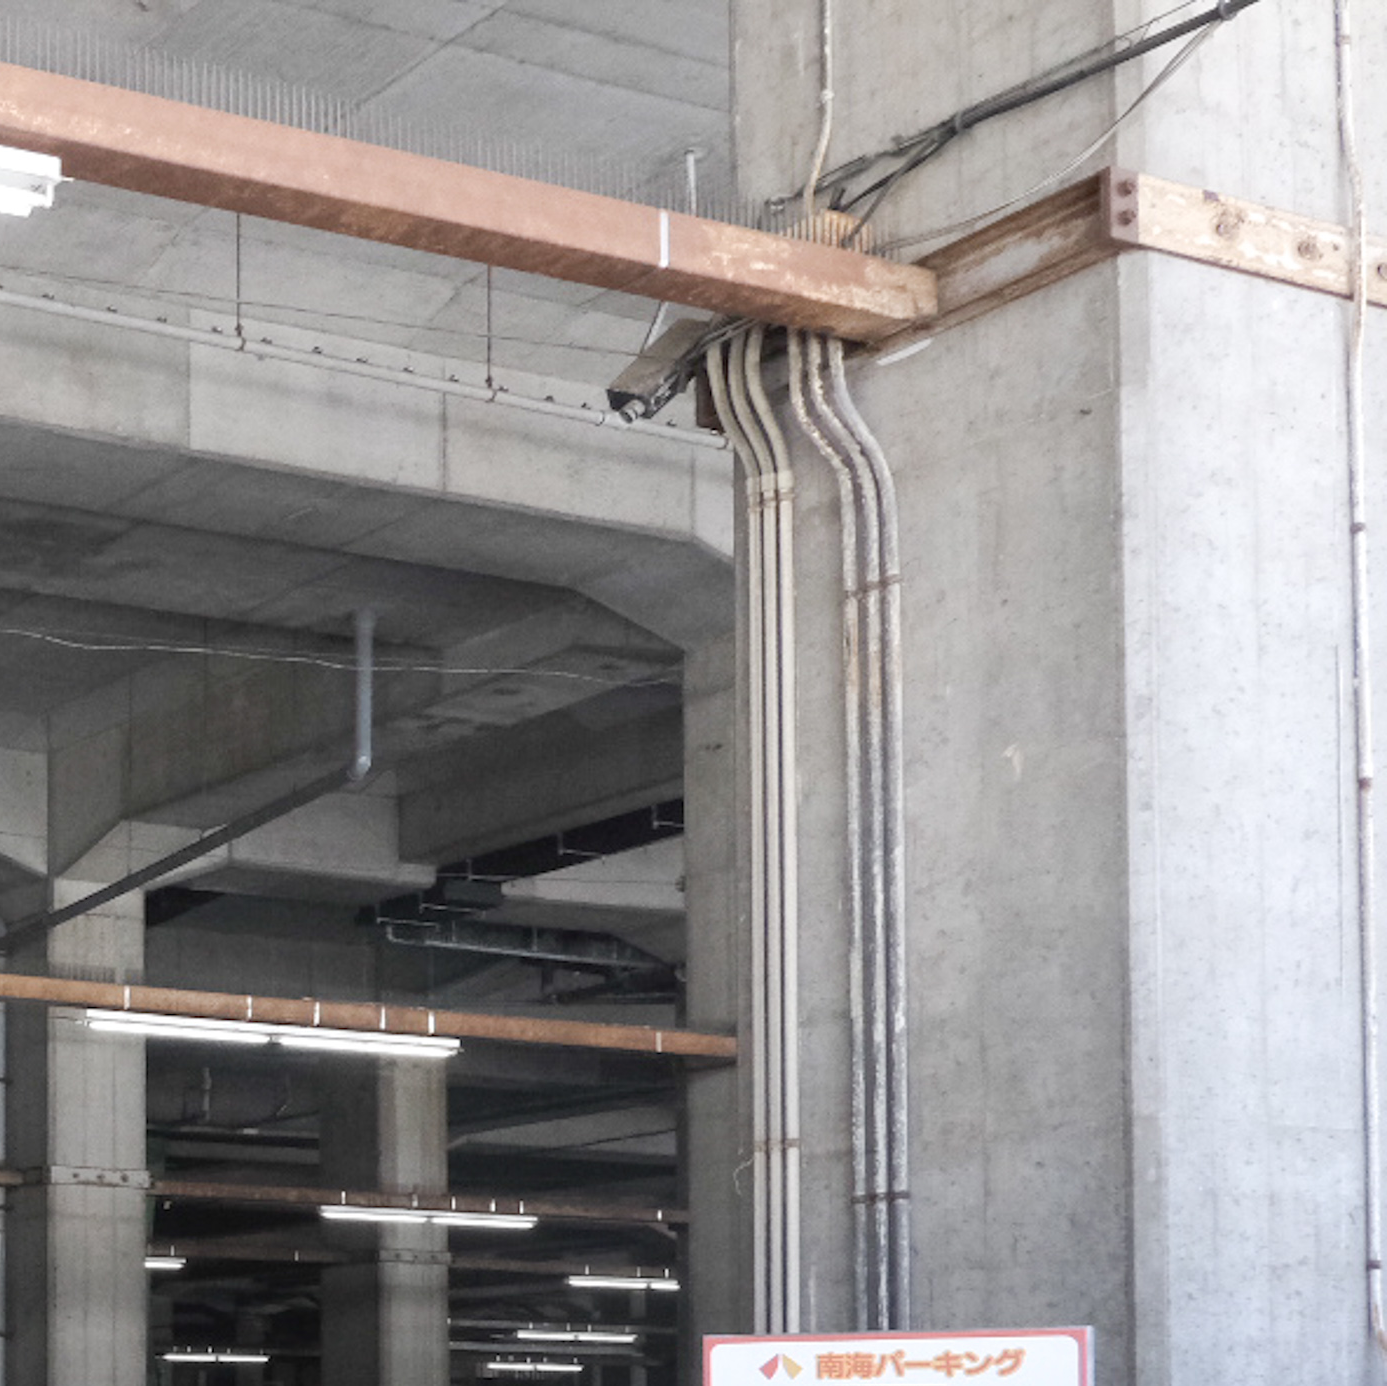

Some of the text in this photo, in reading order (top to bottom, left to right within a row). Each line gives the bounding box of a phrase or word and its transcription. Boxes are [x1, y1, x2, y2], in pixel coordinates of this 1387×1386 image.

[815, 1348, 1026, 1379] 南海パーキング
